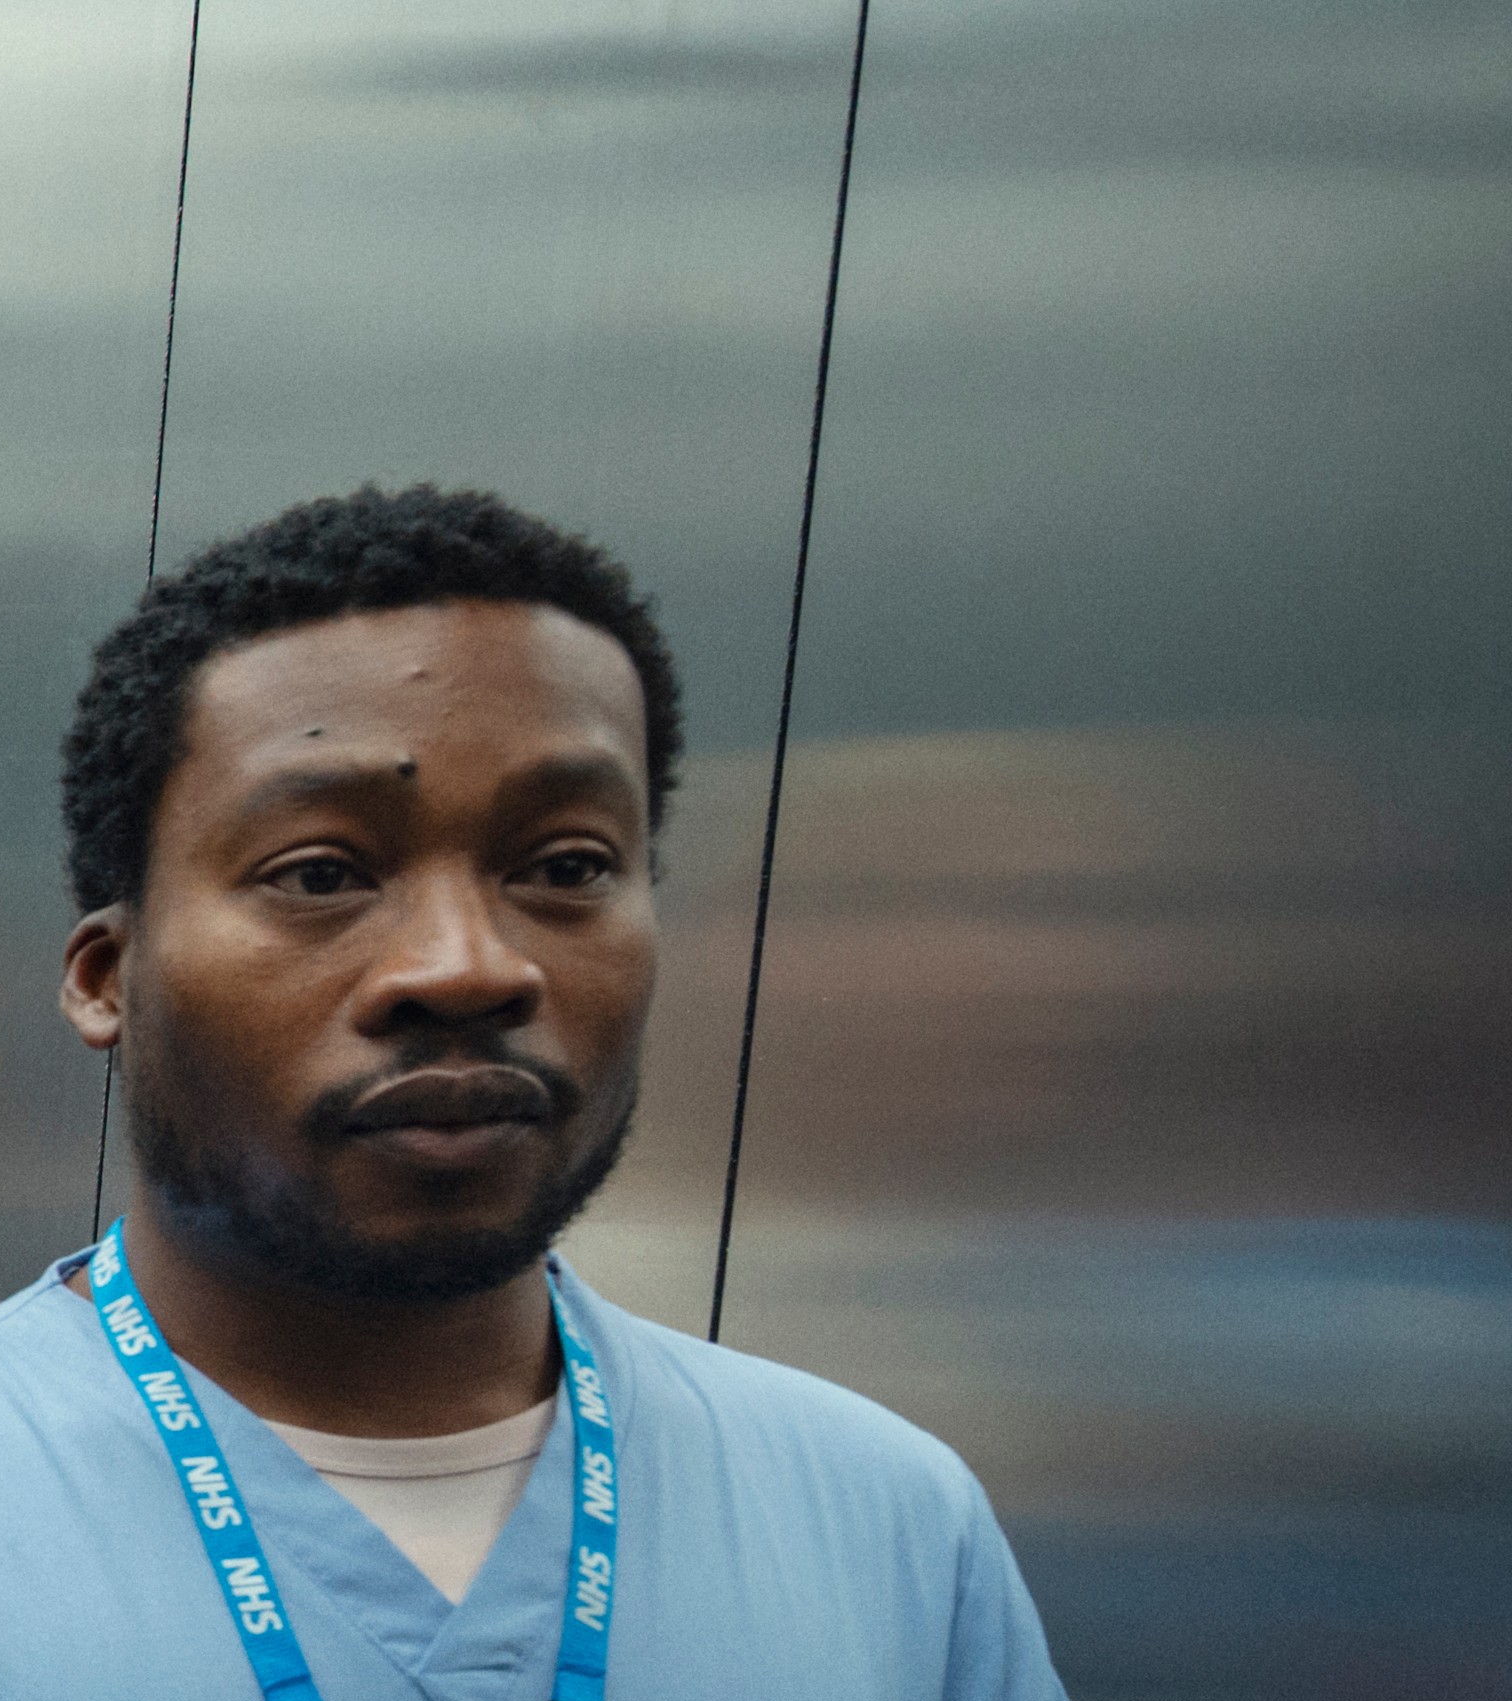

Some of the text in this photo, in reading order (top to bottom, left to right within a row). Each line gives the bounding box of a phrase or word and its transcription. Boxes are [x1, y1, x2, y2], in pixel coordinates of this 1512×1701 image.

[92, 1235, 121, 1287] NHS
[102, 1295, 157, 1356] NHS
[138, 1371, 200, 1431] NHS
[571, 1359, 609, 1428] NHS
[181, 1456, 242, 1530] NHS
[583, 1446, 614, 1525] NHS
[221, 1557, 283, 1634] NHS
[574, 1546, 611, 1631] NHS
